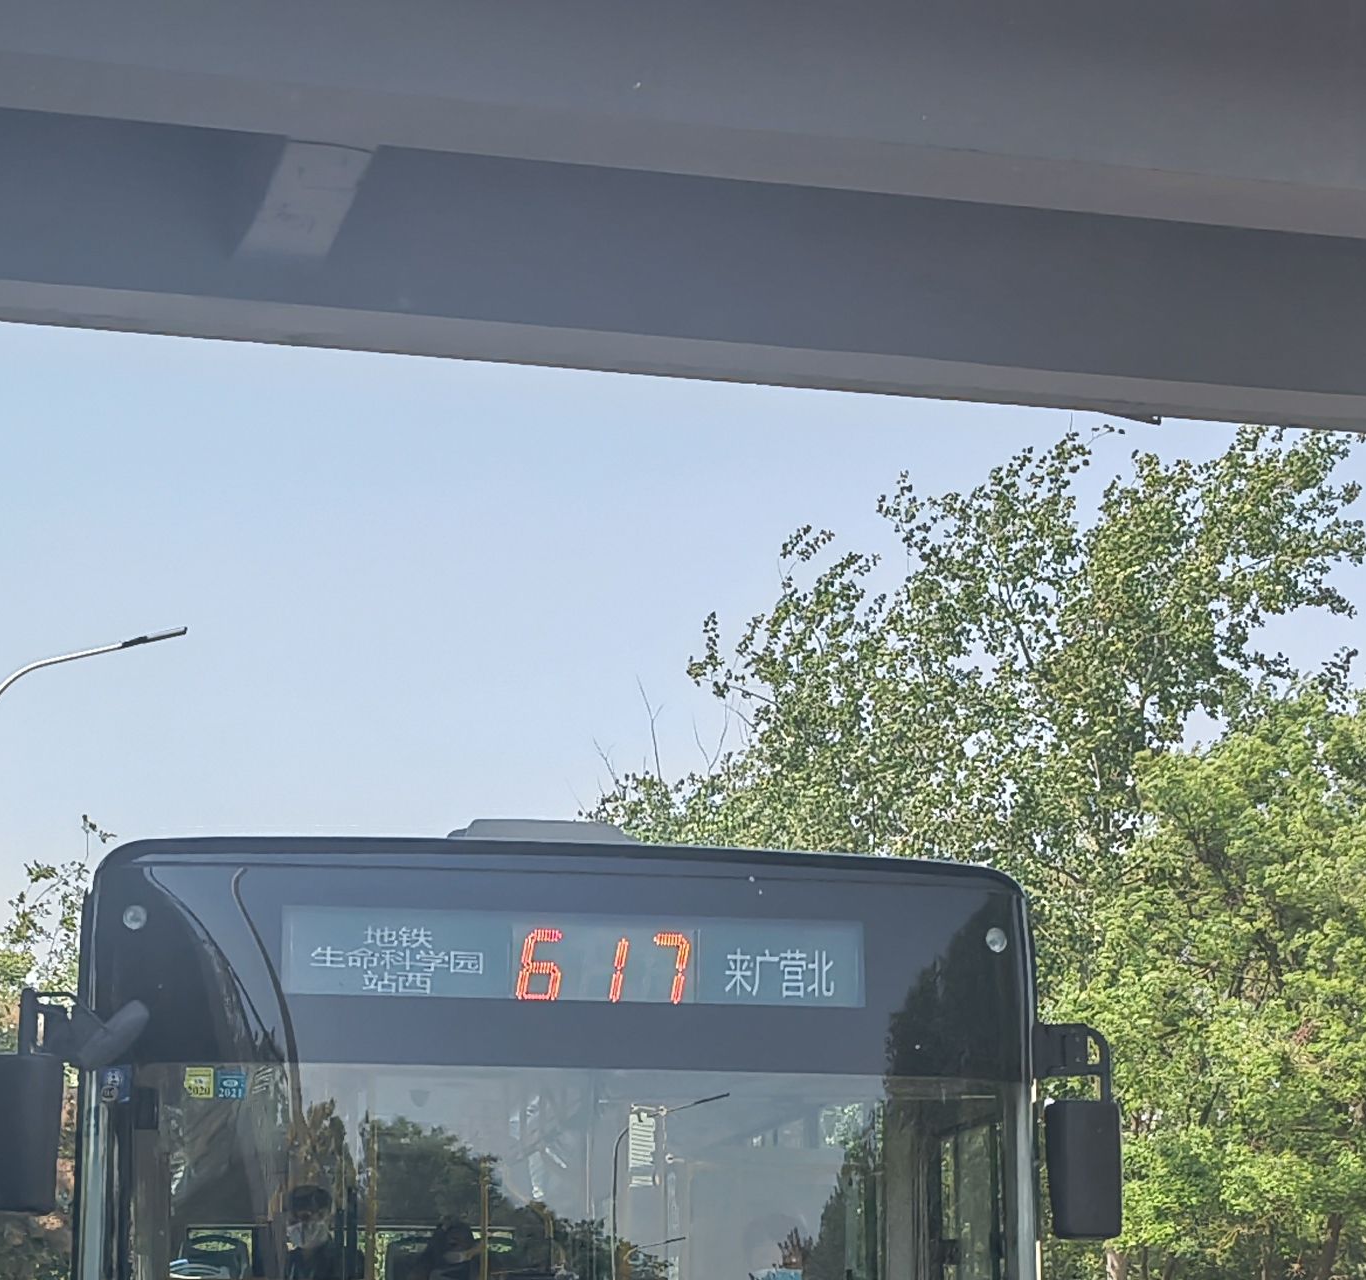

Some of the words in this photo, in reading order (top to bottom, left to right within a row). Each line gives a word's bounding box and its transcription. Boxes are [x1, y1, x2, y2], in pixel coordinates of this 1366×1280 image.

[363, 925, 433, 948] 地铁
[310, 946, 484, 974] 生命科学园
[516, 928, 690, 1004] 617
[363, 970, 432, 994] 站西
[724, 950, 835, 999] 来广营北
